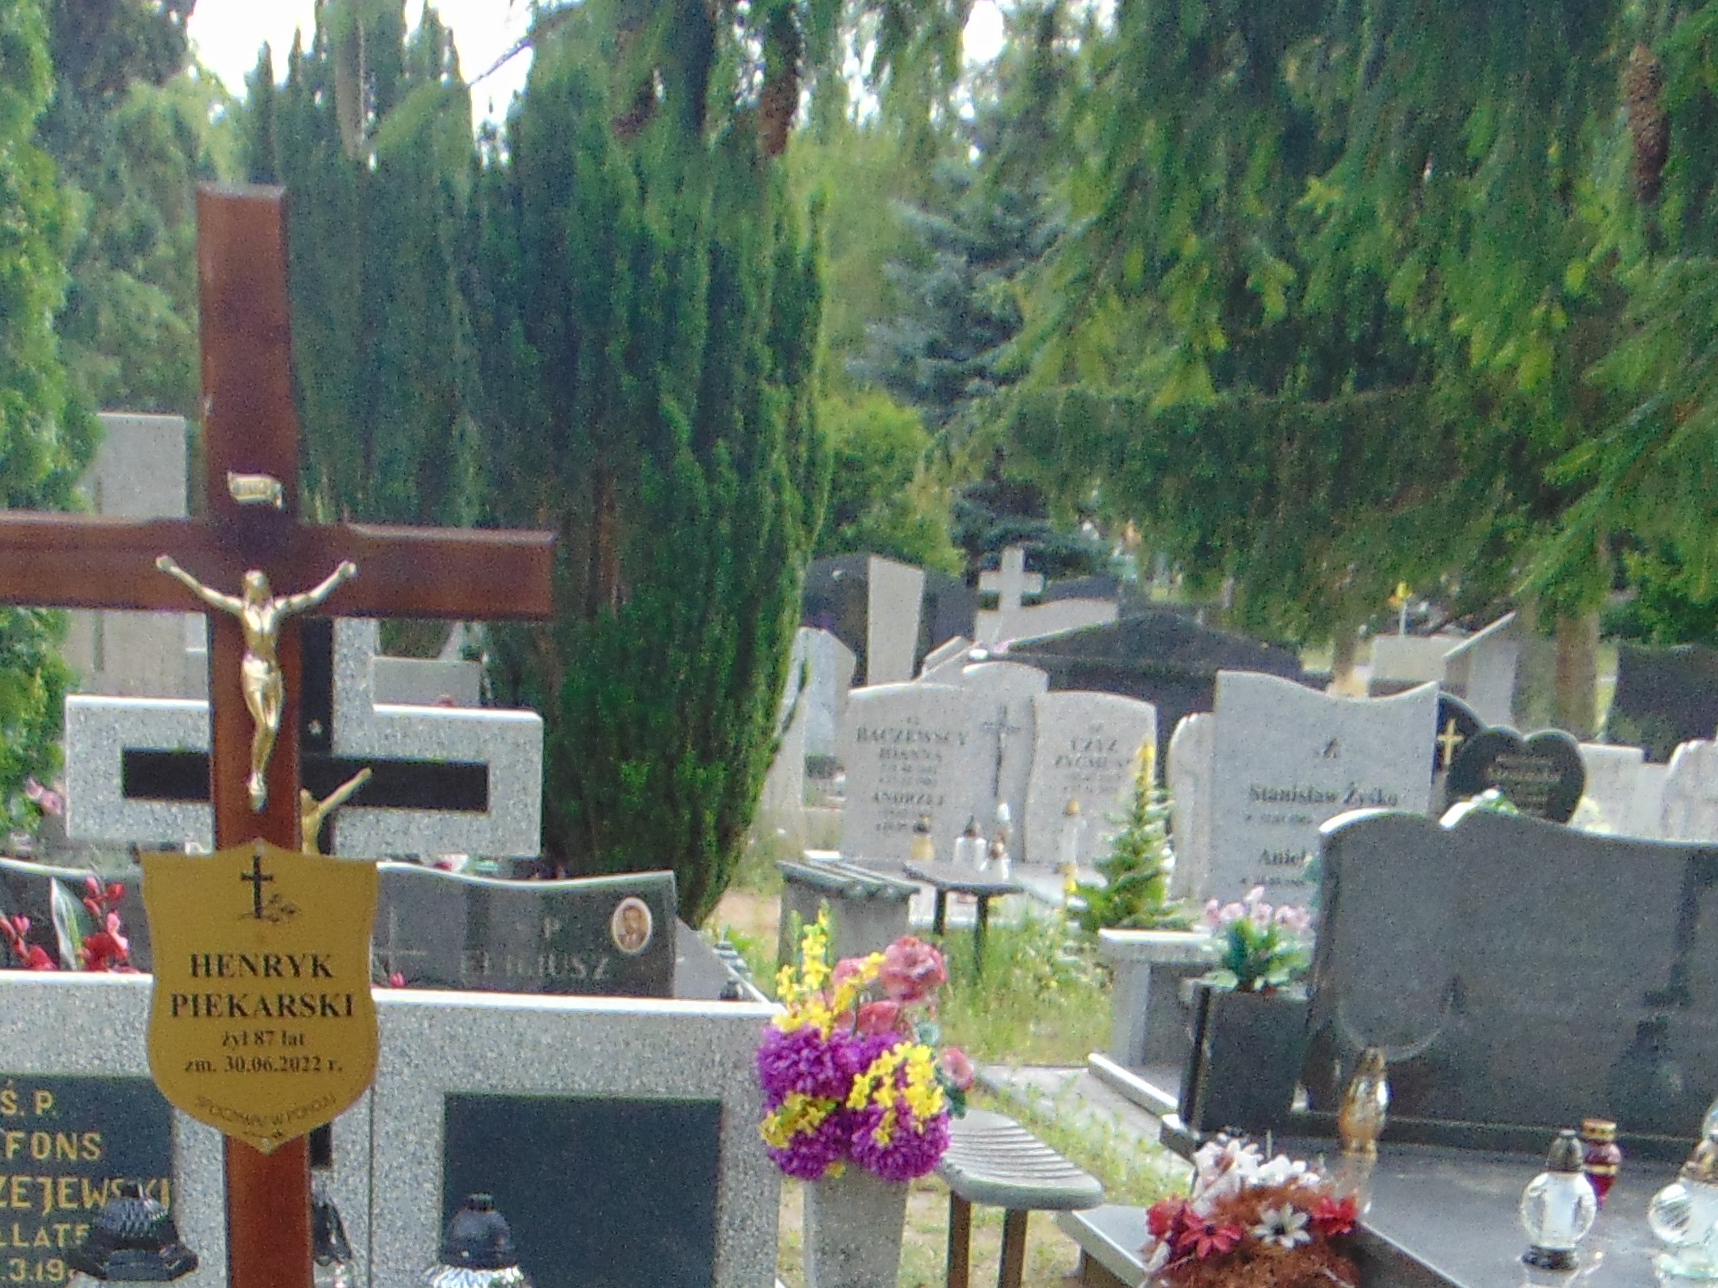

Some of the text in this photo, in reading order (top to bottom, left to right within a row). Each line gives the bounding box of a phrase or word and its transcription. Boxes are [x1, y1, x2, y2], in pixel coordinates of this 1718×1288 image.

[1259, 848, 1306, 866] Aniel
[189, 953, 335, 979] HENRYK
[170, 992, 355, 1018] PIEKARSKI
[254, 1030, 275, 1046] 87
[282, 1029, 305, 1046] lat
[183, 1057, 218, 1073] zm.
[223, 1055, 322, 1073] 30.06.2022
